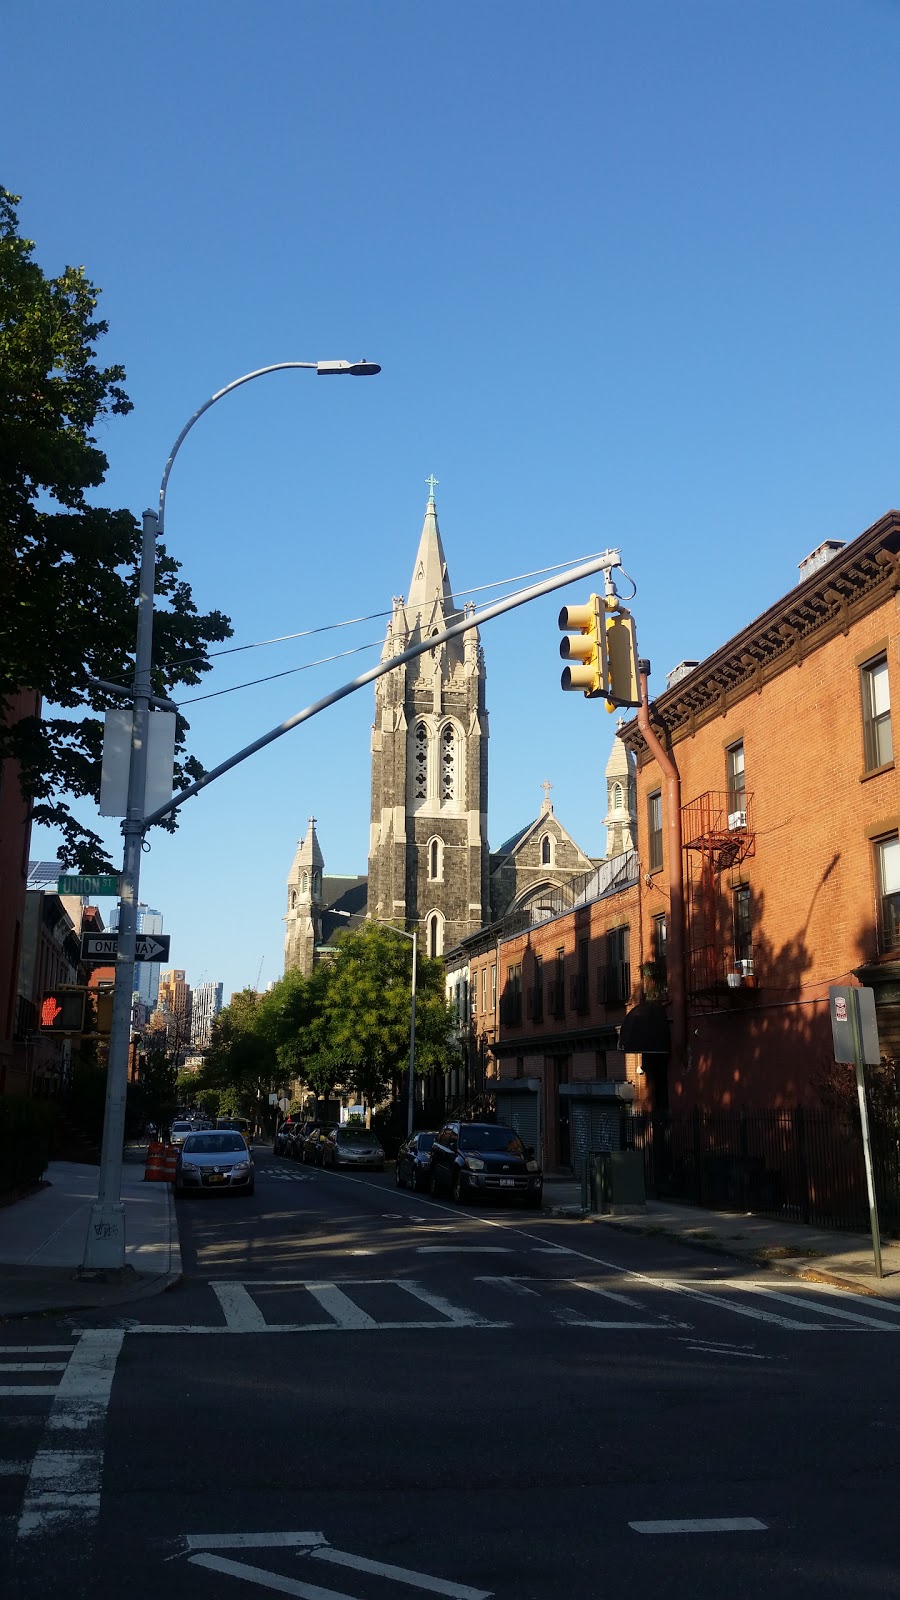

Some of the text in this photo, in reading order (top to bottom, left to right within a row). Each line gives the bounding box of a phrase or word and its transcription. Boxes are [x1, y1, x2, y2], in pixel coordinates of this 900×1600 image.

[63, 877, 112, 893] UNION ST
[95, 941, 118, 952] ONE
